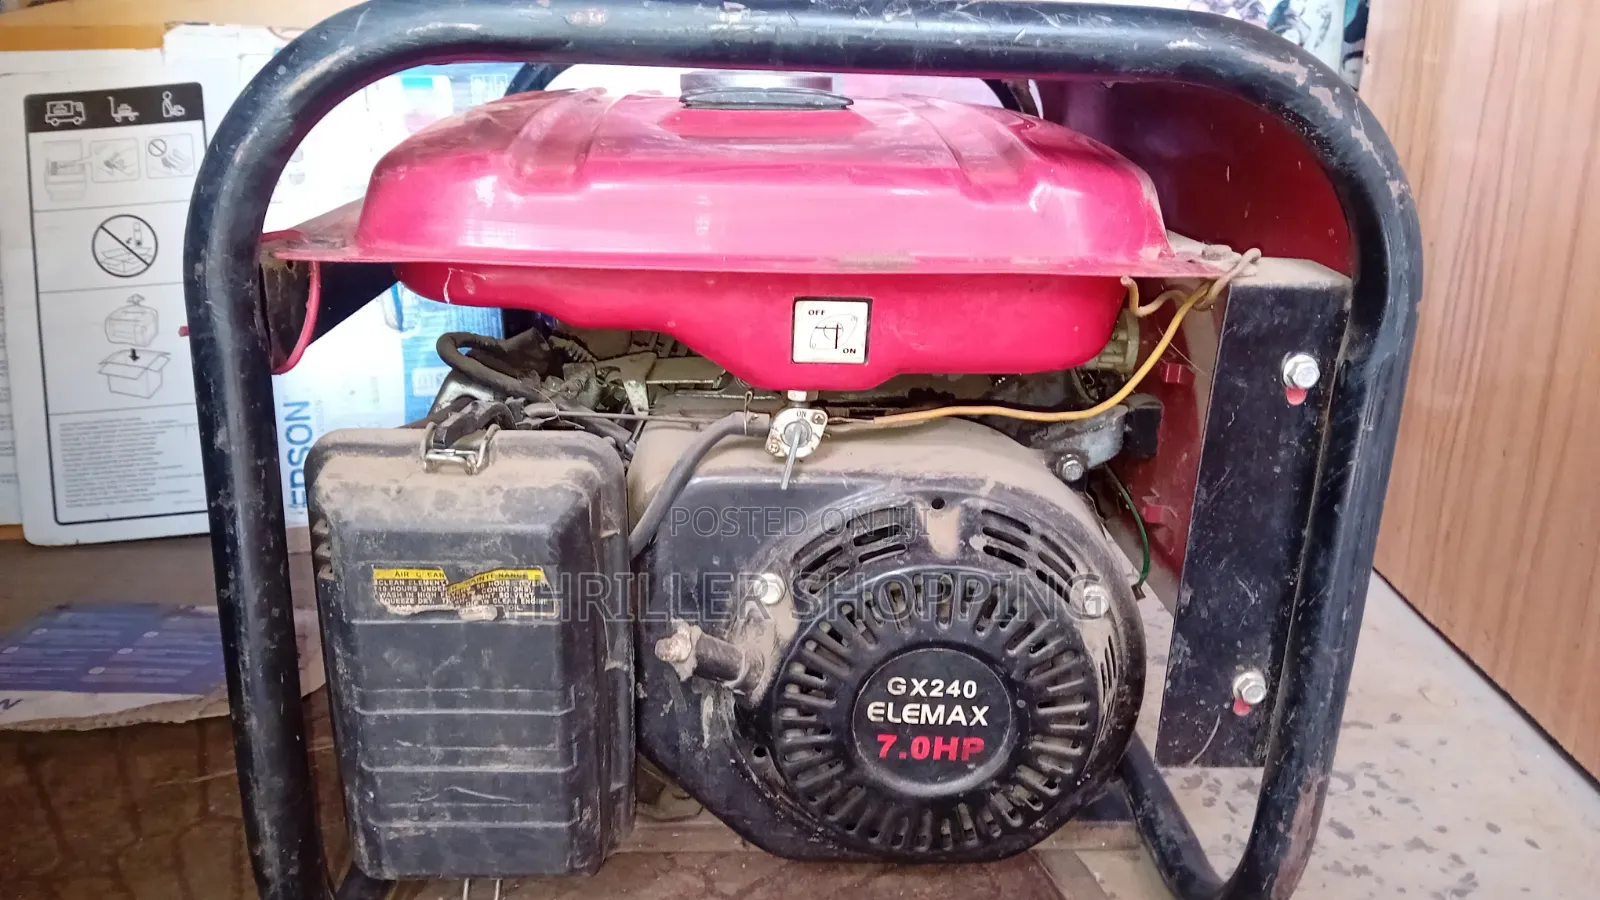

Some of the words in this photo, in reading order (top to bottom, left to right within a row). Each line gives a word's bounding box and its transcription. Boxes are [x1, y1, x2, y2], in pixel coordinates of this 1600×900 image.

[796, 410, 807, 418] ON
[887, 676, 977, 699] GX240
[867, 701, 990, 727] ELEMAX
[877, 733, 985, 761] 7.0HP
